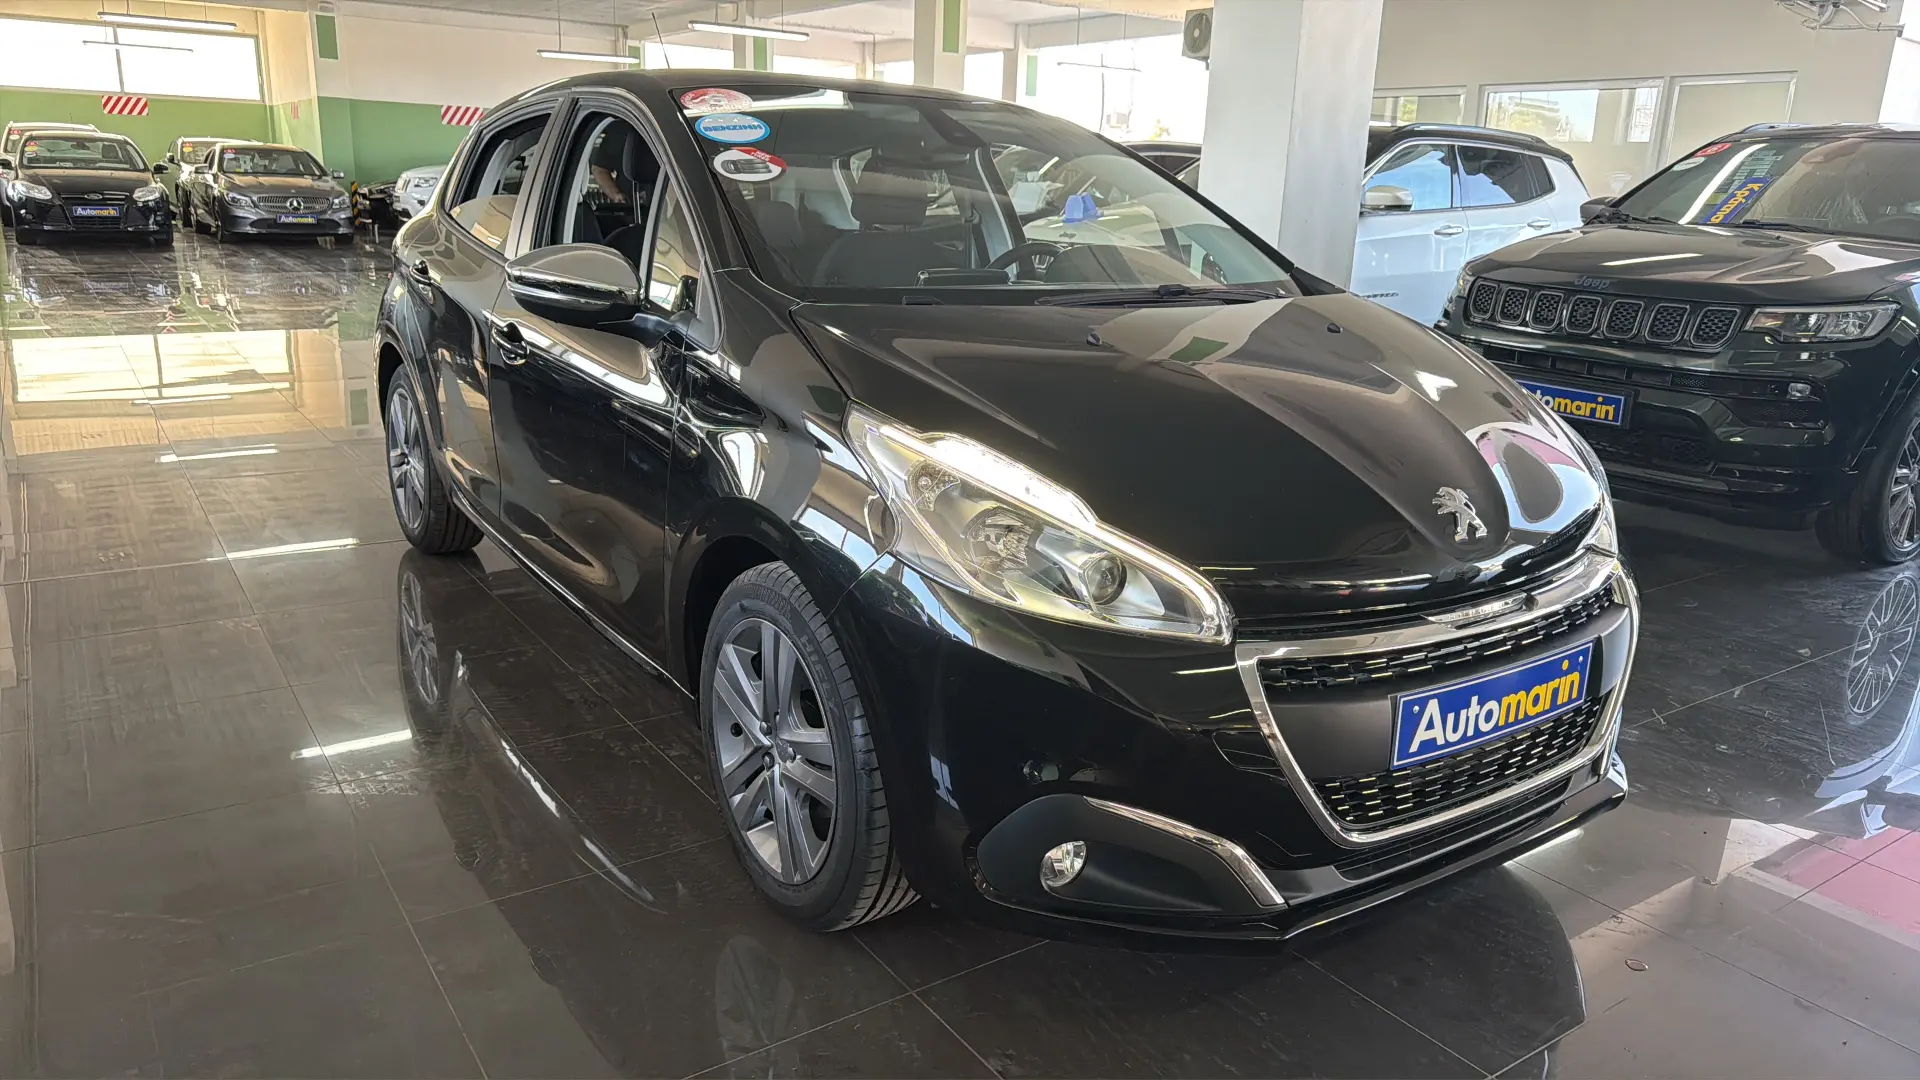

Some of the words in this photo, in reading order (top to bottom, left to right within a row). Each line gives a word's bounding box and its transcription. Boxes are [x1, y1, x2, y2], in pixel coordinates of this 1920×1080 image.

[77, 207, 117, 217] Automarin
[280, 215, 315, 223] Automarin
[1574, 275, 1611, 290] Jeep
[1534, 389, 1616, 421] tomarin
[1409, 659, 1581, 753] Automarin
